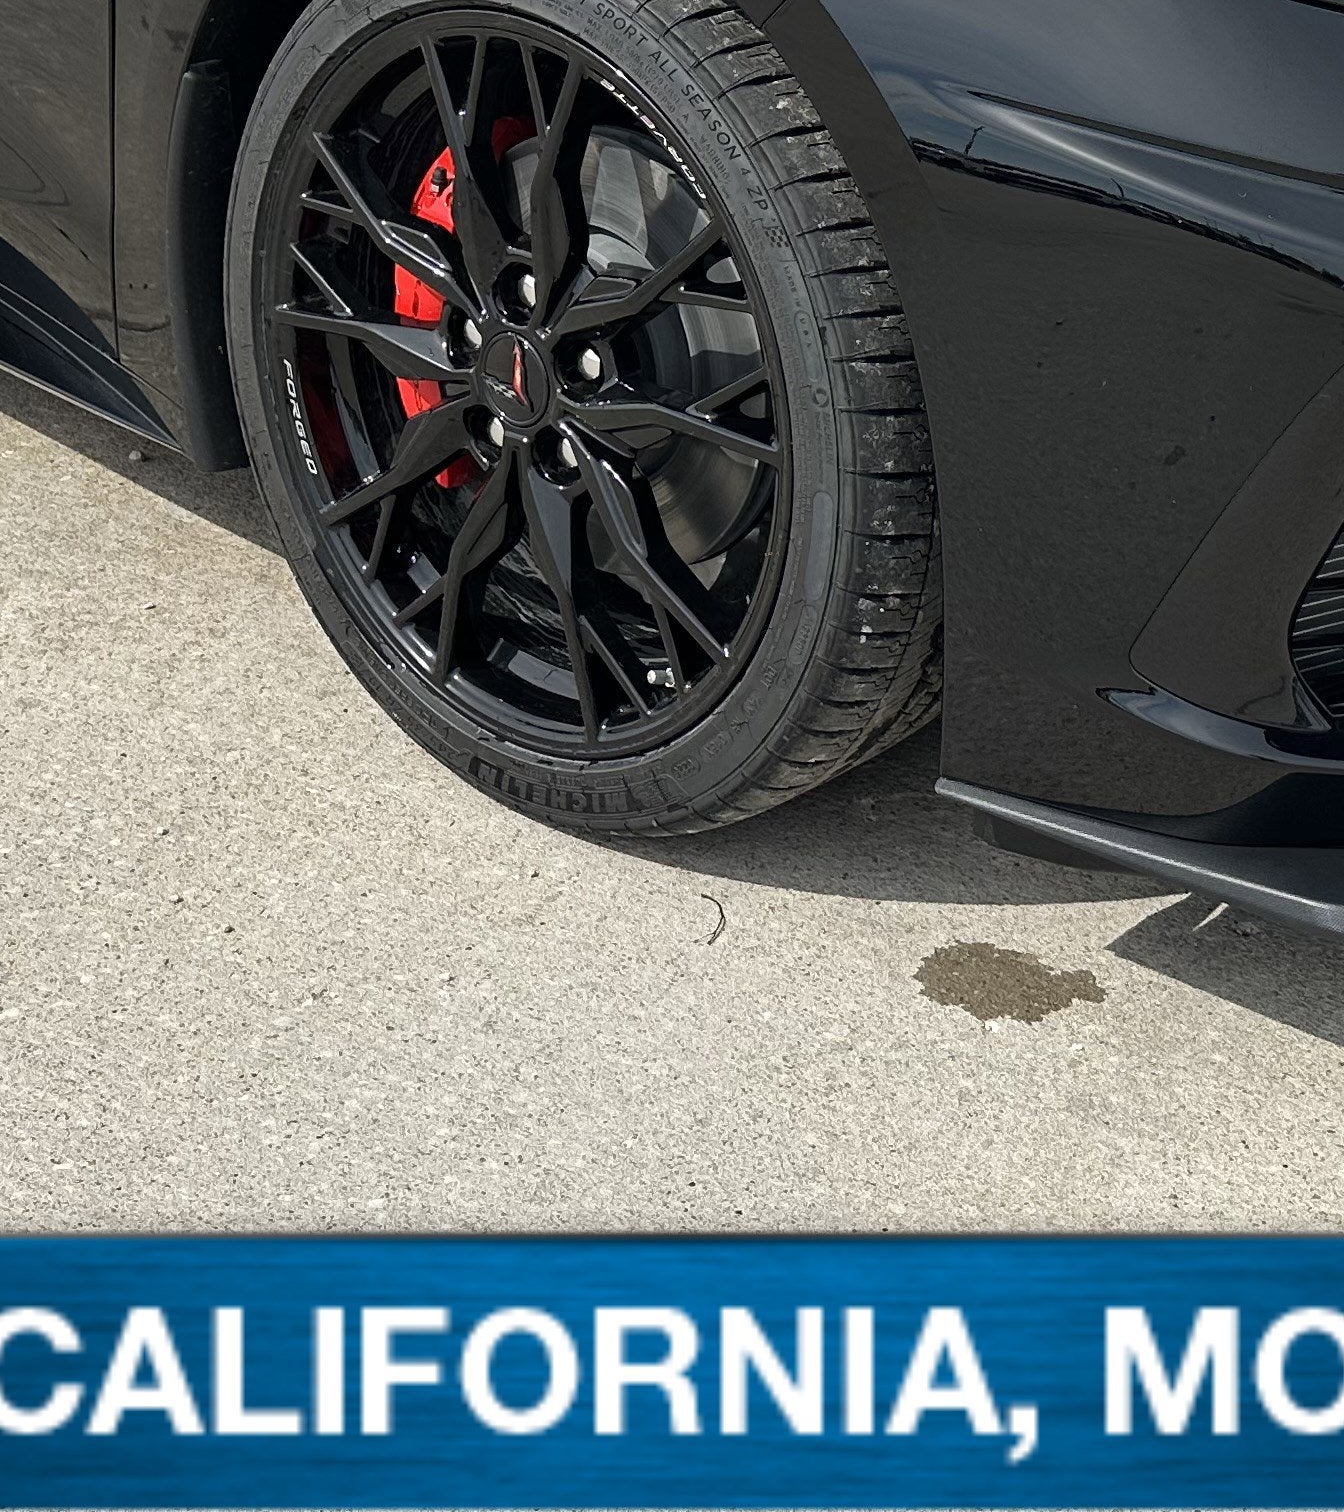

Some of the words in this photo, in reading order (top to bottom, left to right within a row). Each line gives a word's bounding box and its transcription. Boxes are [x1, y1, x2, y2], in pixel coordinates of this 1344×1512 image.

[592, 1, 649, 48] SPORT
[647, 49, 680, 83] ALL
[681, 84, 742, 162] SEASON
[739, 167, 752, 179] 4
[746, 185, 770, 212] ZP
[599, 78, 707, 199] CORVETTE
[283, 357, 319, 476] FORGED
[476, 764, 628, 813] MICHELIN
